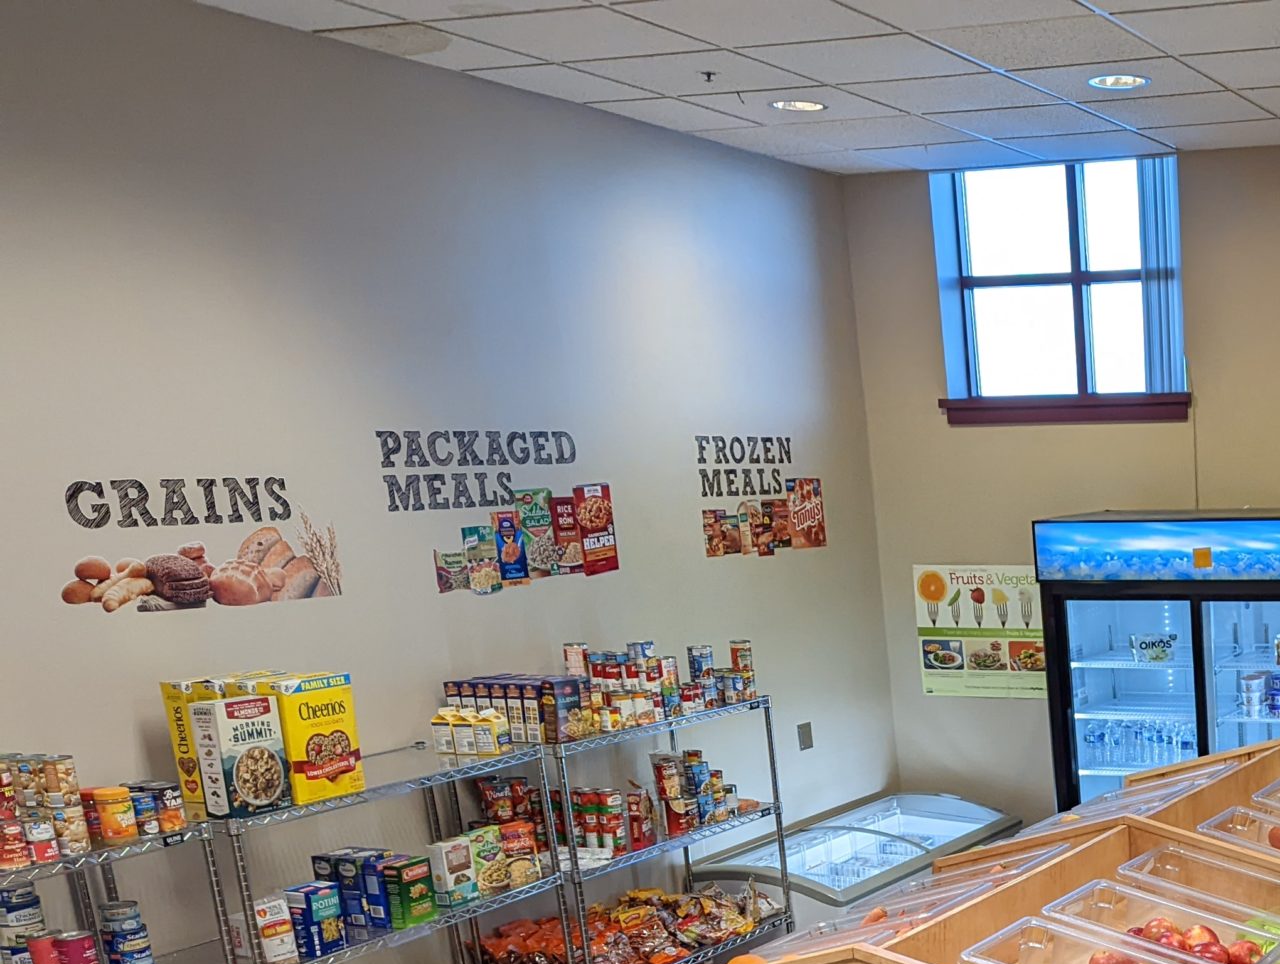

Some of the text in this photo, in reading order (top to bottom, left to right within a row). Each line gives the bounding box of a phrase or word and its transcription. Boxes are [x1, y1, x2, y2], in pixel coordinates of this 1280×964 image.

[375, 429, 577, 469] PACKAGED
[695, 436, 792, 464] FROZEN
[383, 471, 515, 512] MEALS
[699, 468, 782, 496] MEALS
[65, 476, 292, 529] GRAINS
[791, 502, 822, 531] Tony's
[583, 535, 615, 550] HELPER
[950, 572, 984, 586] Fruits
[986, 575, 994, 584] &
[1139, 640, 1173, 650] OIKOS
[301, 673, 346, 690] FAMILY SIZE
[299, 699, 346, 721] Cheerios
[173, 706, 190, 755] Cheerios
[232, 720, 271, 732] MORNING
[232, 728, 273, 743] SUMMIT
[312, 895, 339, 910] ROTINI
